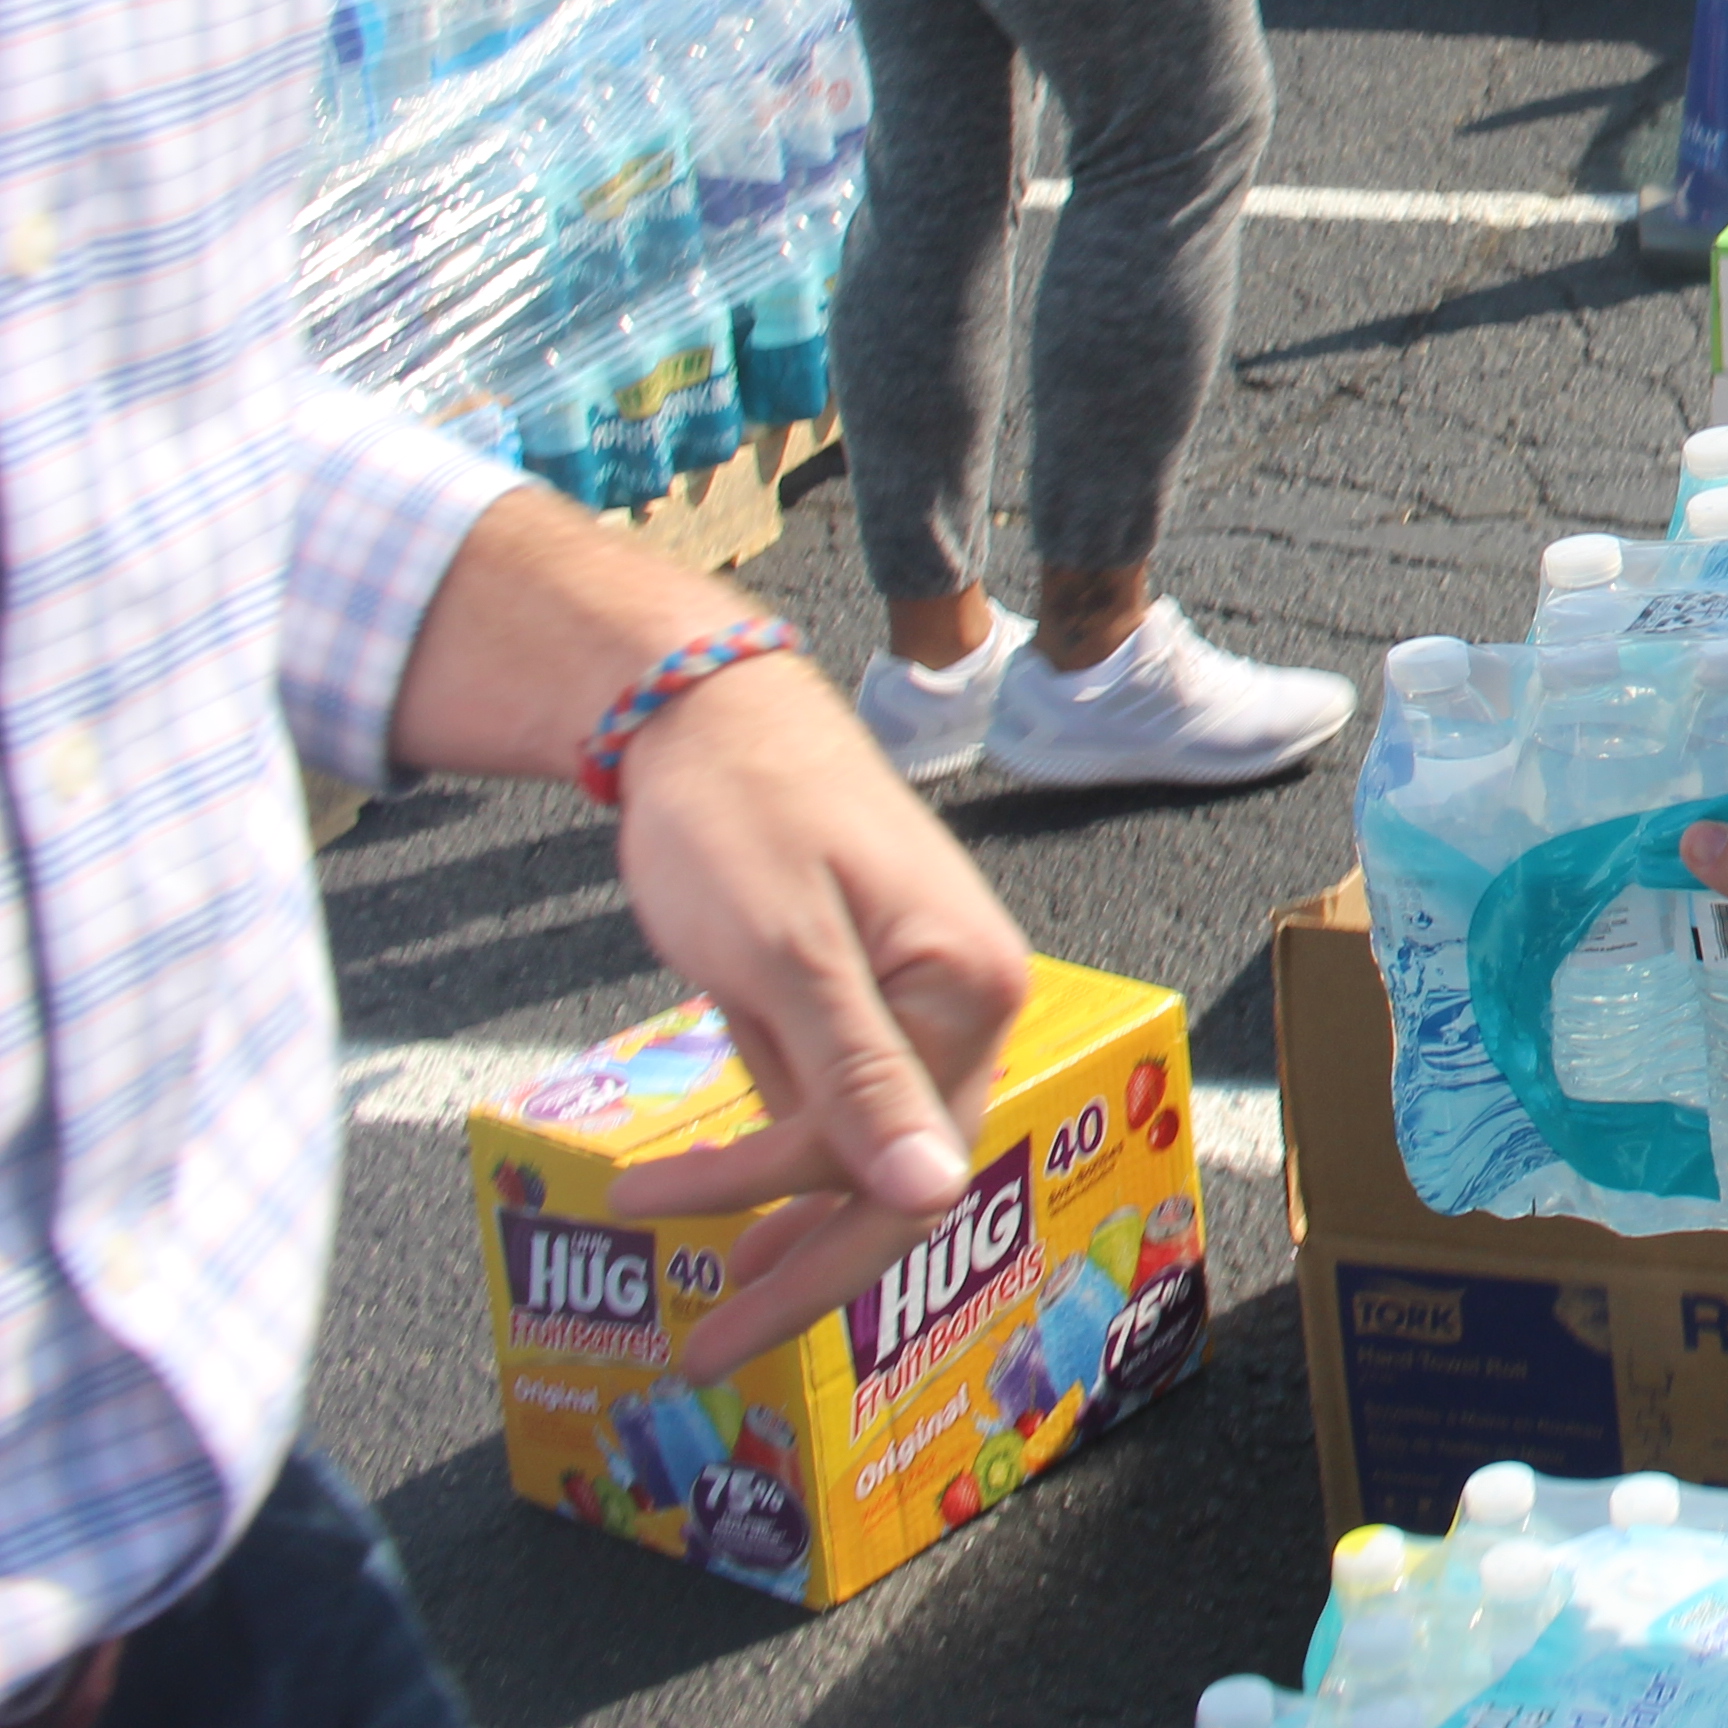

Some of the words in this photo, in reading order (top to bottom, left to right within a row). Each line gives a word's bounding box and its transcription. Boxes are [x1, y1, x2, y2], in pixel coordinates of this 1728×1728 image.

[1043, 1094, 1109, 1180] 40
[527, 1229, 649, 1317] HUG
[665, 1244, 725, 1301] 40
[874, 1176, 1023, 1367] HUG
[850, 1332, 928, 1449] Fruit
[926, 1239, 1047, 1369] Barrels
[1106, 1266, 1193, 1371] 75%
[513, 1374, 600, 1414] Original
[854, 1381, 971, 1501] Original
[701, 1463, 786, 1515] 75%
